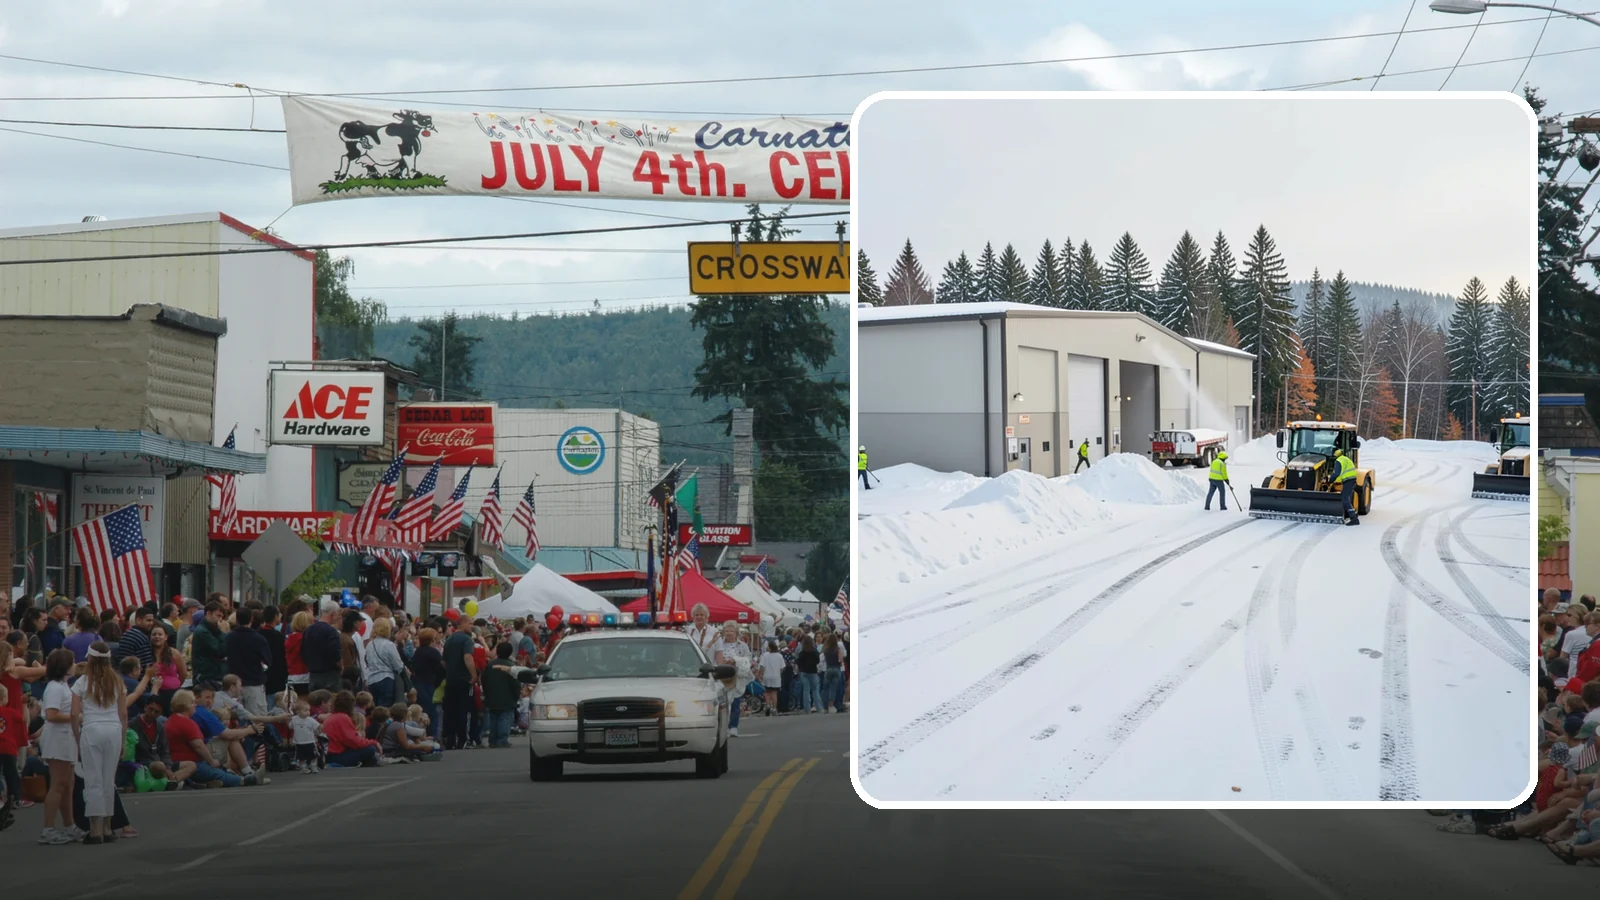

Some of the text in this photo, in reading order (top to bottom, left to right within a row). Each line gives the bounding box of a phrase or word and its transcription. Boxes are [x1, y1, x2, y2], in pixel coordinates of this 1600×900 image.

[481, 141, 605, 192] JULY
[632, 150, 746, 198] 4th.
[696, 254, 850, 280] CROSSWA
[283, 380, 373, 420] ACE
[406, 409, 452, 422] CEDAR
[283, 421, 370, 436] Hardware
[416, 428, 476, 447] Coca-Cola
[83, 485, 155, 495] St. Vincent de Paul
[212, 516, 332, 538] HARDARE
[688, 526, 741, 535] CRNATION
[699, 535, 730, 543] GLASS
